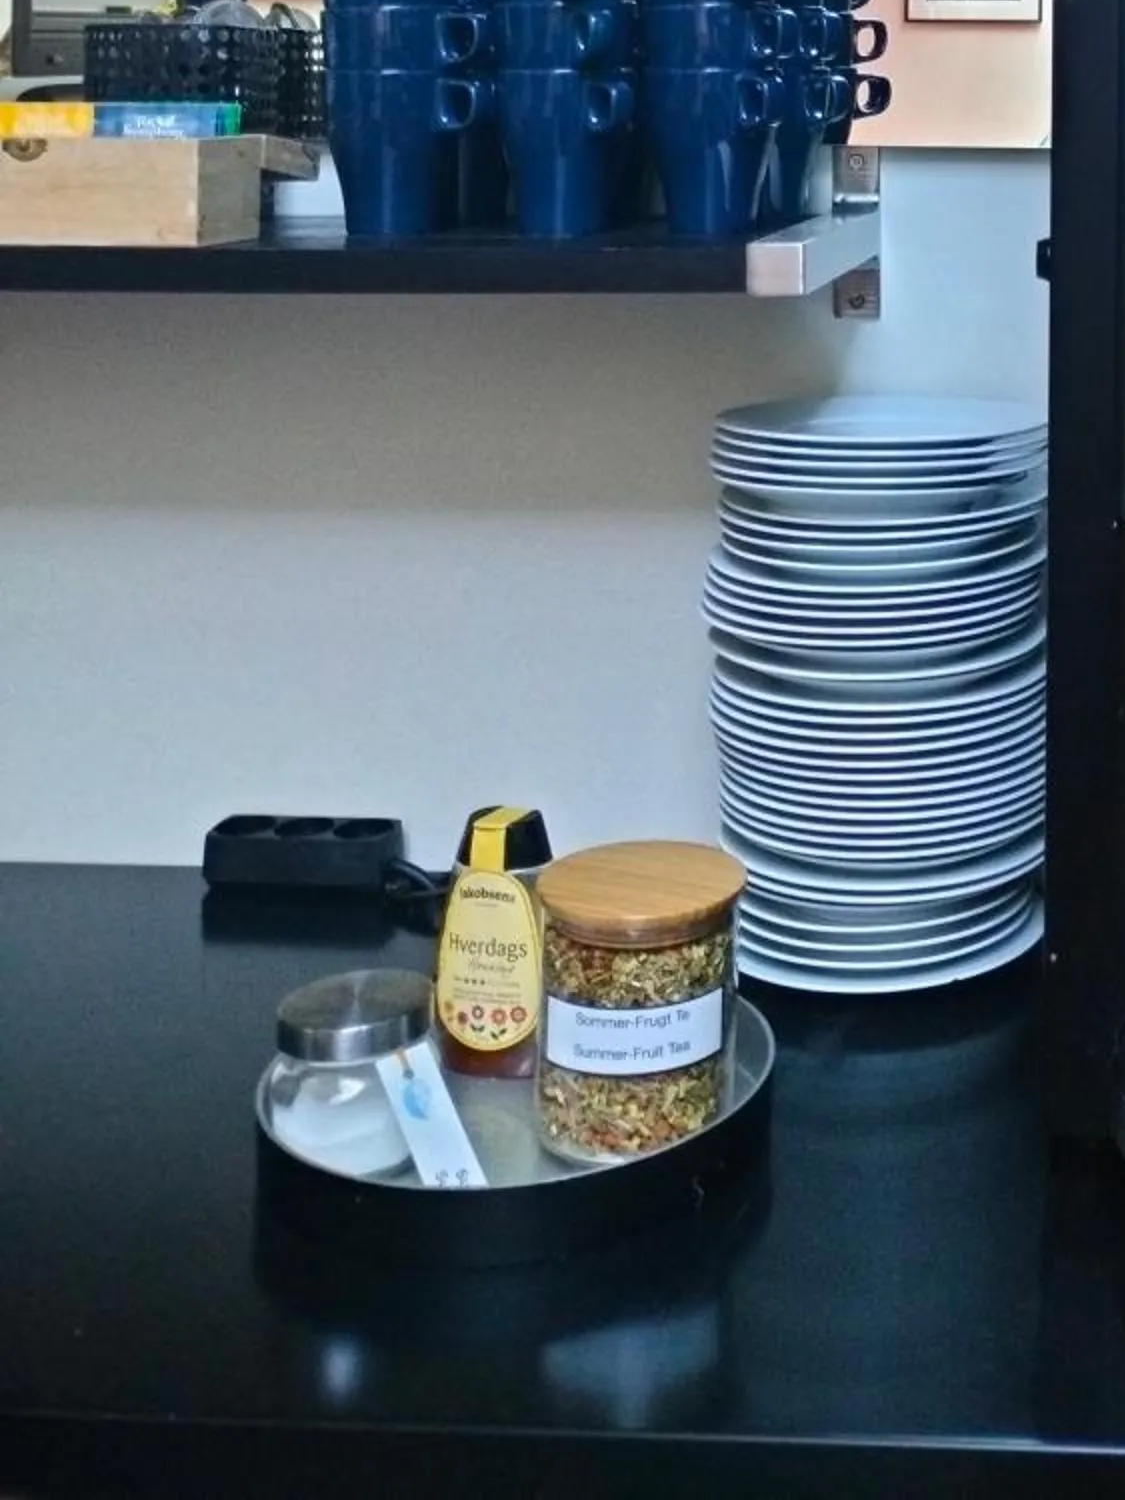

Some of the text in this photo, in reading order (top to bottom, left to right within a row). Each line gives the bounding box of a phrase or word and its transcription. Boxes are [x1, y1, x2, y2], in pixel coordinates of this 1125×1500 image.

[449, 931, 528, 962] Hverdags
[575, 1009, 690, 1029] Sommer-Frugt Te
[573, 1040, 691, 1061] Summer-Fruit Tea
